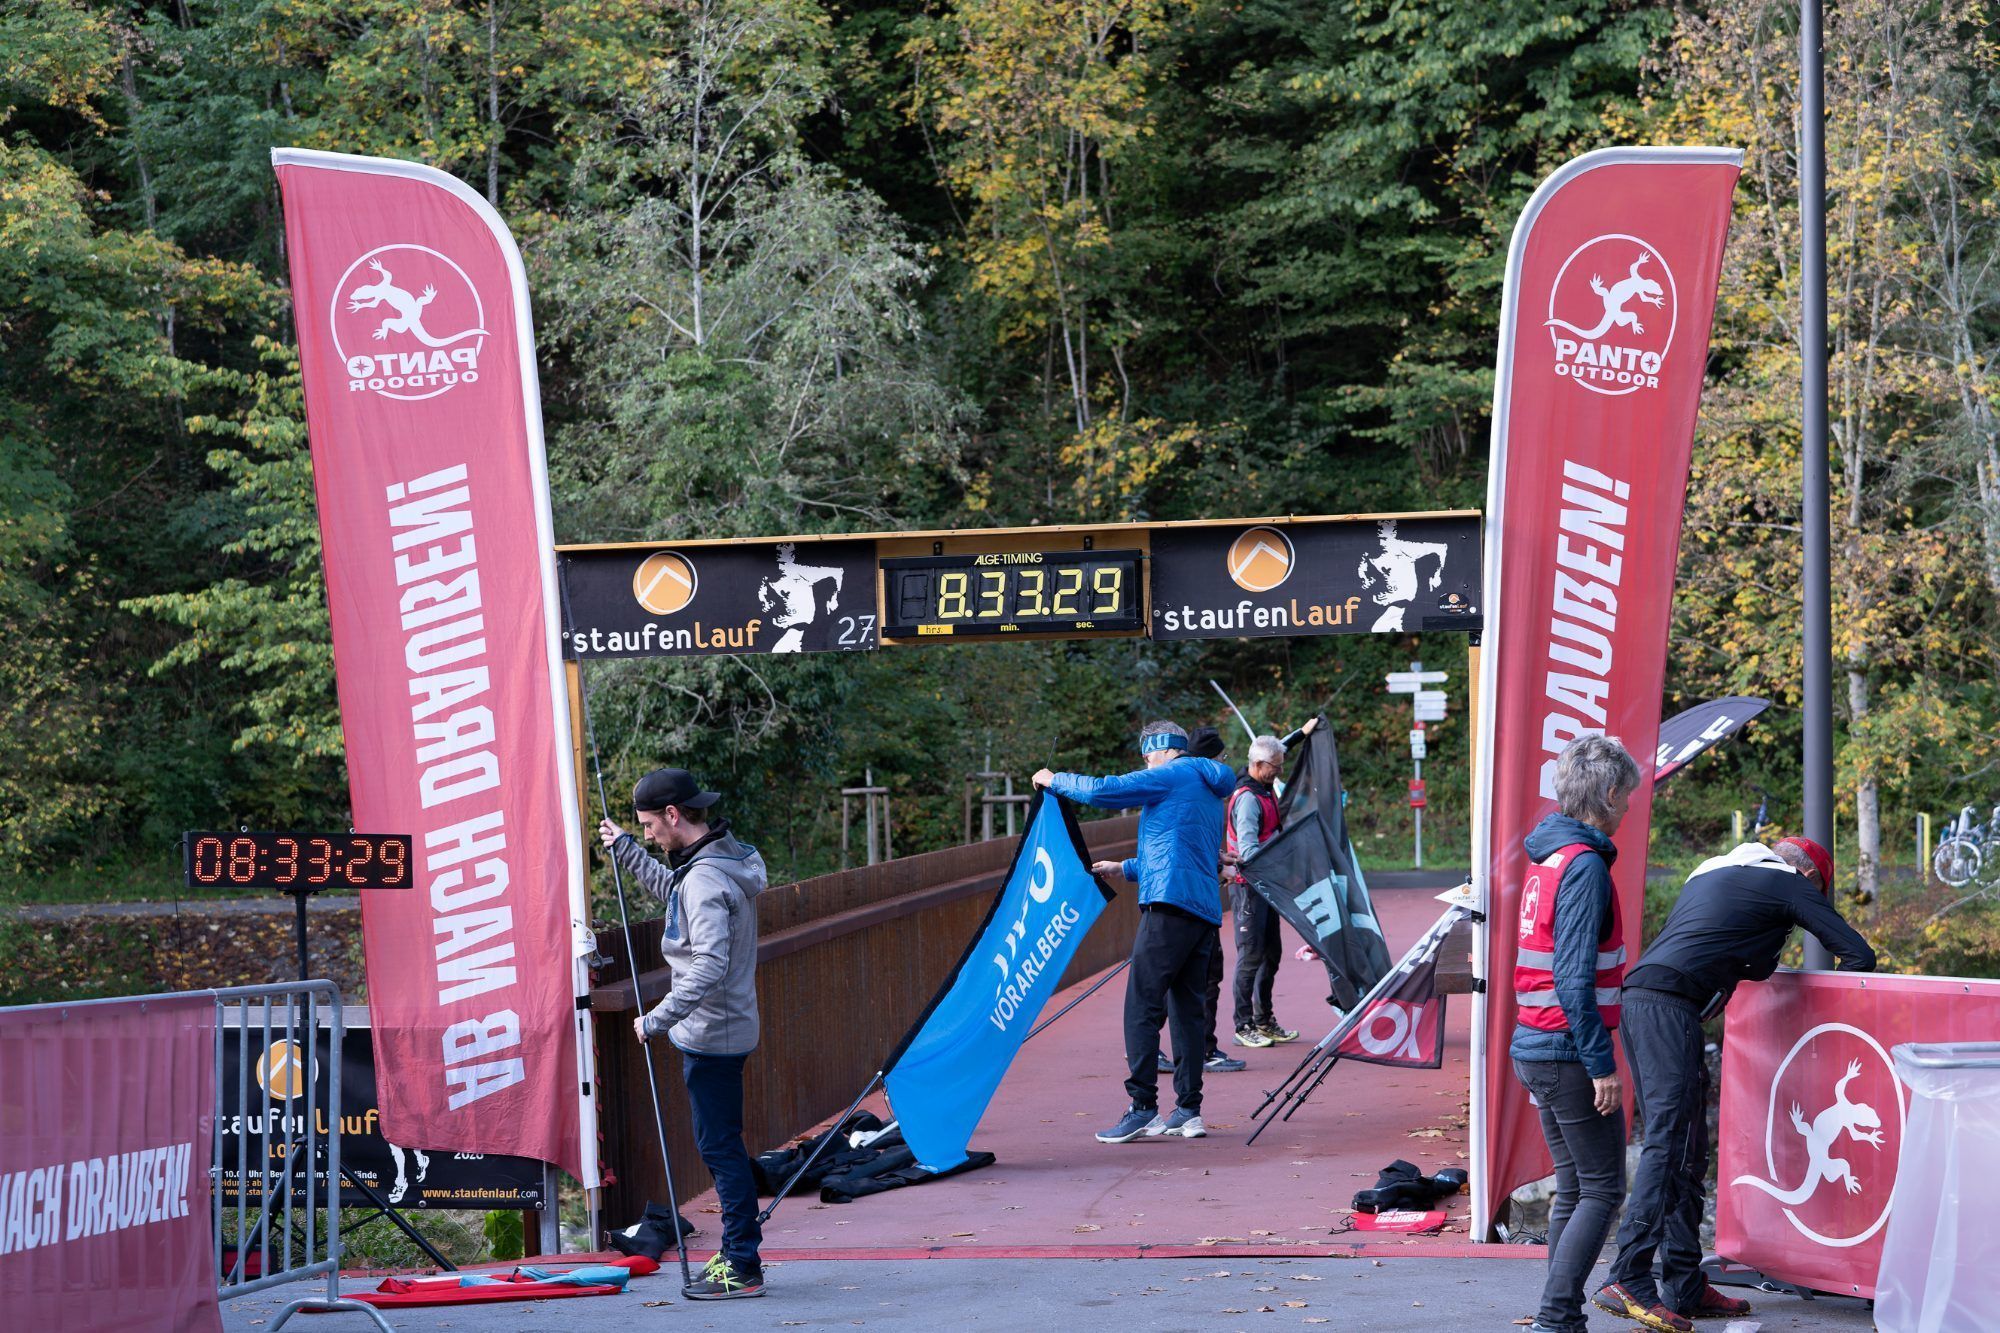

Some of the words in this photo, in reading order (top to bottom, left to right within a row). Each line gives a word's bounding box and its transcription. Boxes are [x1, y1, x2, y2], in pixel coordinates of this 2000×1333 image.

[1555, 338, 1661, 375] PANTO
[1554, 363, 1659, 389] OUTDOOR
[974, 552, 1043, 566] ALGE-TIMING
[938, 567, 1122, 619] 8.33.29
[1000, 623, 1020, 632] min.
[1075, 621, 1095, 629] sec.
[1164, 596, 1362, 631] staufenlauf
[573, 618, 762, 653] staufenlauf
[195, 837, 405, 883] 08:33:29
[989, 900, 1080, 1032] VORARLBERG
[66, 1142, 192, 1242] DRAUßEN!
[422, 1187, 538, 1199] www.staufenlauf.com
